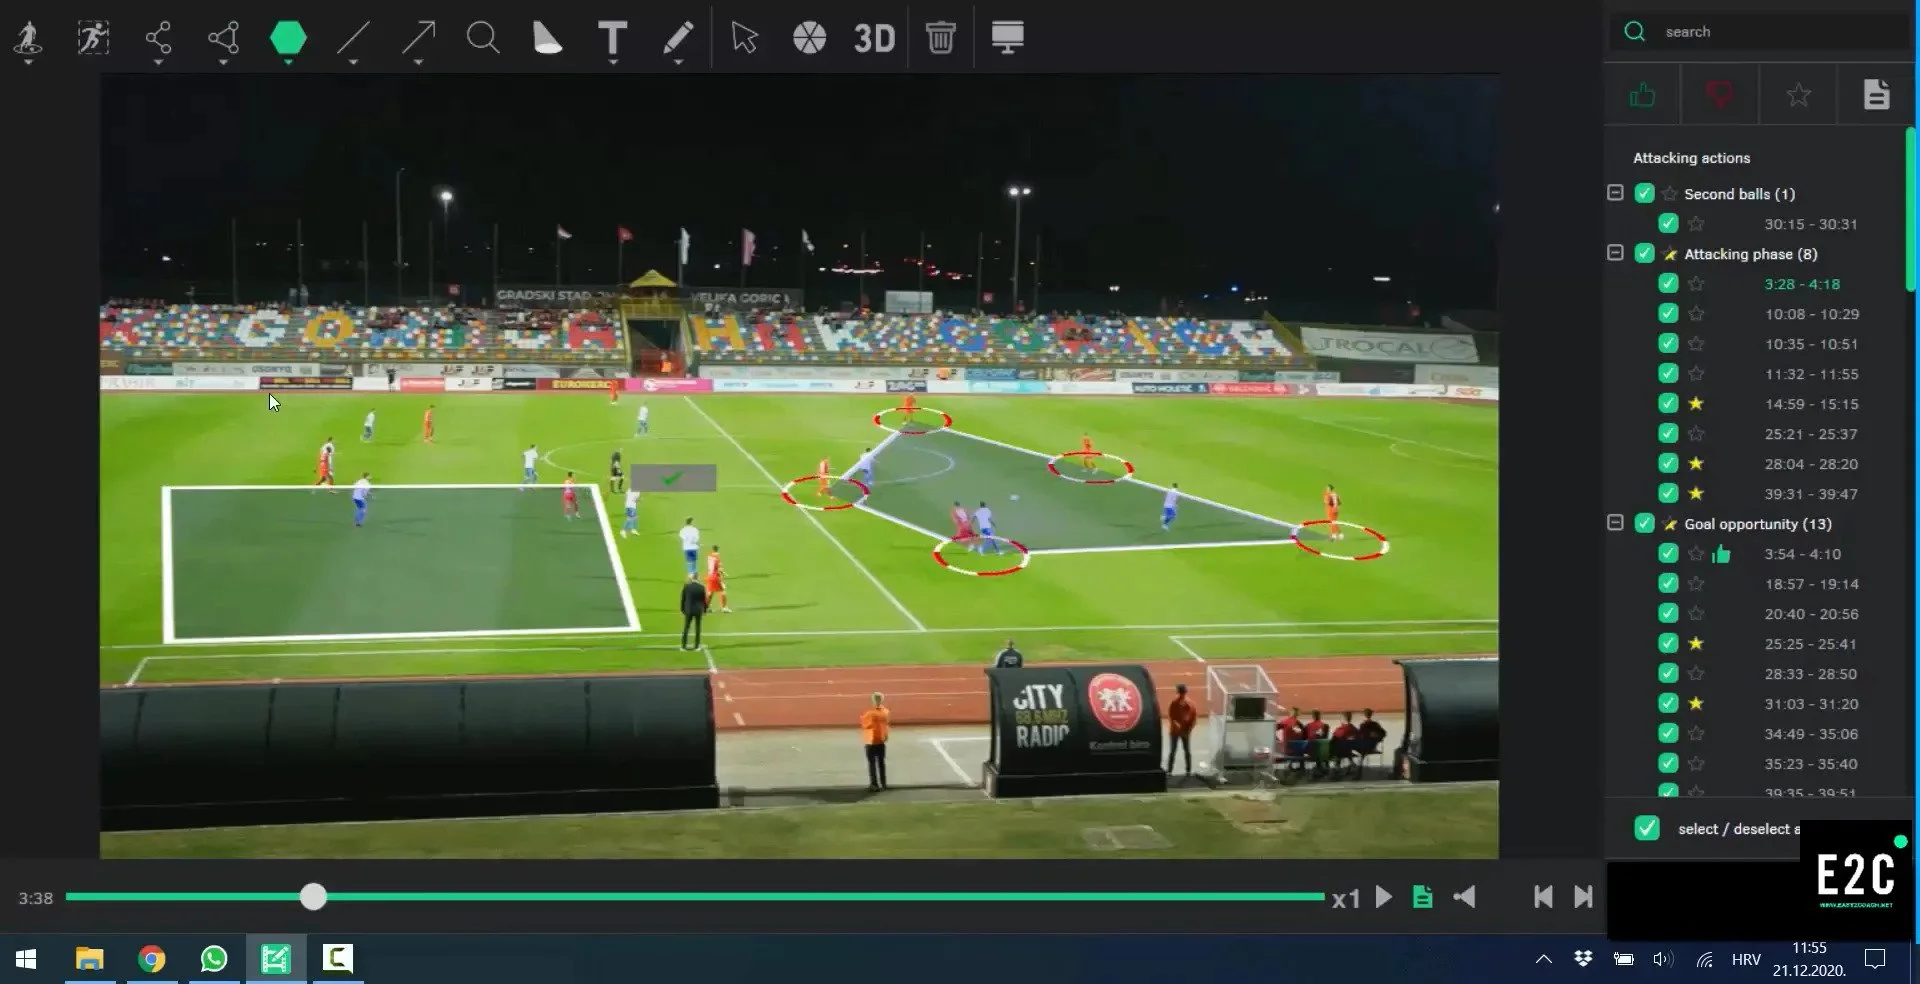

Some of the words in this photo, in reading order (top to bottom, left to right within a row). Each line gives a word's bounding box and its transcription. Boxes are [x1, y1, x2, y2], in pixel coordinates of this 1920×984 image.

[854, 23, 896, 53] 3D
[1666, 25, 1711, 38] search
[1632, 151, 1699, 167] Attacking
[1702, 152, 1751, 164] actions
[1684, 187, 1735, 201] Second
[1738, 187, 1771, 201] balls
[1774, 187, 1796, 203] (1)
[1764, 218, 1805, 230] 30:15
[1819, 218, 1857, 231] 30:31
[1684, 247, 1750, 263] Attacking
[1752, 247, 1794, 263] phase
[1797, 247, 1819, 263] (8)
[1764, 278, 1796, 291] 3:28
[1808, 278, 1841, 290] 4:18
[496, 290, 555, 302] GRADSKI
[1766, 308, 1806, 321] 10:08
[1820, 308, 1860, 320] 10:29
[1766, 338, 1805, 351] 10:35
[1820, 338, 1857, 351] 10:51
[1766, 368, 1805, 381] 11:32
[1820, 368, 1859, 380] 11:55
[1765, 398, 1806, 410] 14:59
[1820, 398, 1859, 410] 15:15
[1765, 428, 1802, 441] 25:21
[1818, 428, 1858, 440] 25:37
[1765, 458, 1805, 471] 28:04
[1819, 458, 1859, 470] 28:20
[1764, 488, 1802, 500] 39:31
[1818, 488, 1858, 501] 39:47
[1684, 517, 1716, 531] Goal
[1719, 518, 1800, 533] opportunity
[1801, 517, 1833, 533] (13)
[1764, 548, 1795, 560] 3:54
[1808, 548, 1842, 560] 4:10
[1766, 578, 1805, 590] 18:57
[1820, 578, 1860, 590] 19:14
[1764, 608, 1806, 620] 20:40
[1819, 608, 1860, 621] 20:56
[1765, 638, 1804, 650] 25:25
[1818, 638, 1856, 650] 25:41
[1765, 668, 1804, 680] 28:33
[1818, 668, 1858, 680] 28:50
[1013, 684, 1064, 710] CITY
[1765, 698, 1805, 710] 31:03
[1819, 698, 1859, 710] 31:20
[1764, 728, 1805, 740] 34:49
[1819, 728, 1859, 740] 35:06
[1765, 758, 1804, 770] 35:23
[1817, 758, 1859, 770] 35:40
[1678, 822, 1720, 836] select
[1721, 821, 1731, 838] /
[1733, 822, 1791, 836] deselect
[19, 891, 54, 905] 3:38
[1331, 888, 1360, 909] x1
[1792, 941, 1828, 954] 11:55
[1732, 953, 1762, 966] HRV
[1772, 964, 1847, 977] 21.12.2020.
